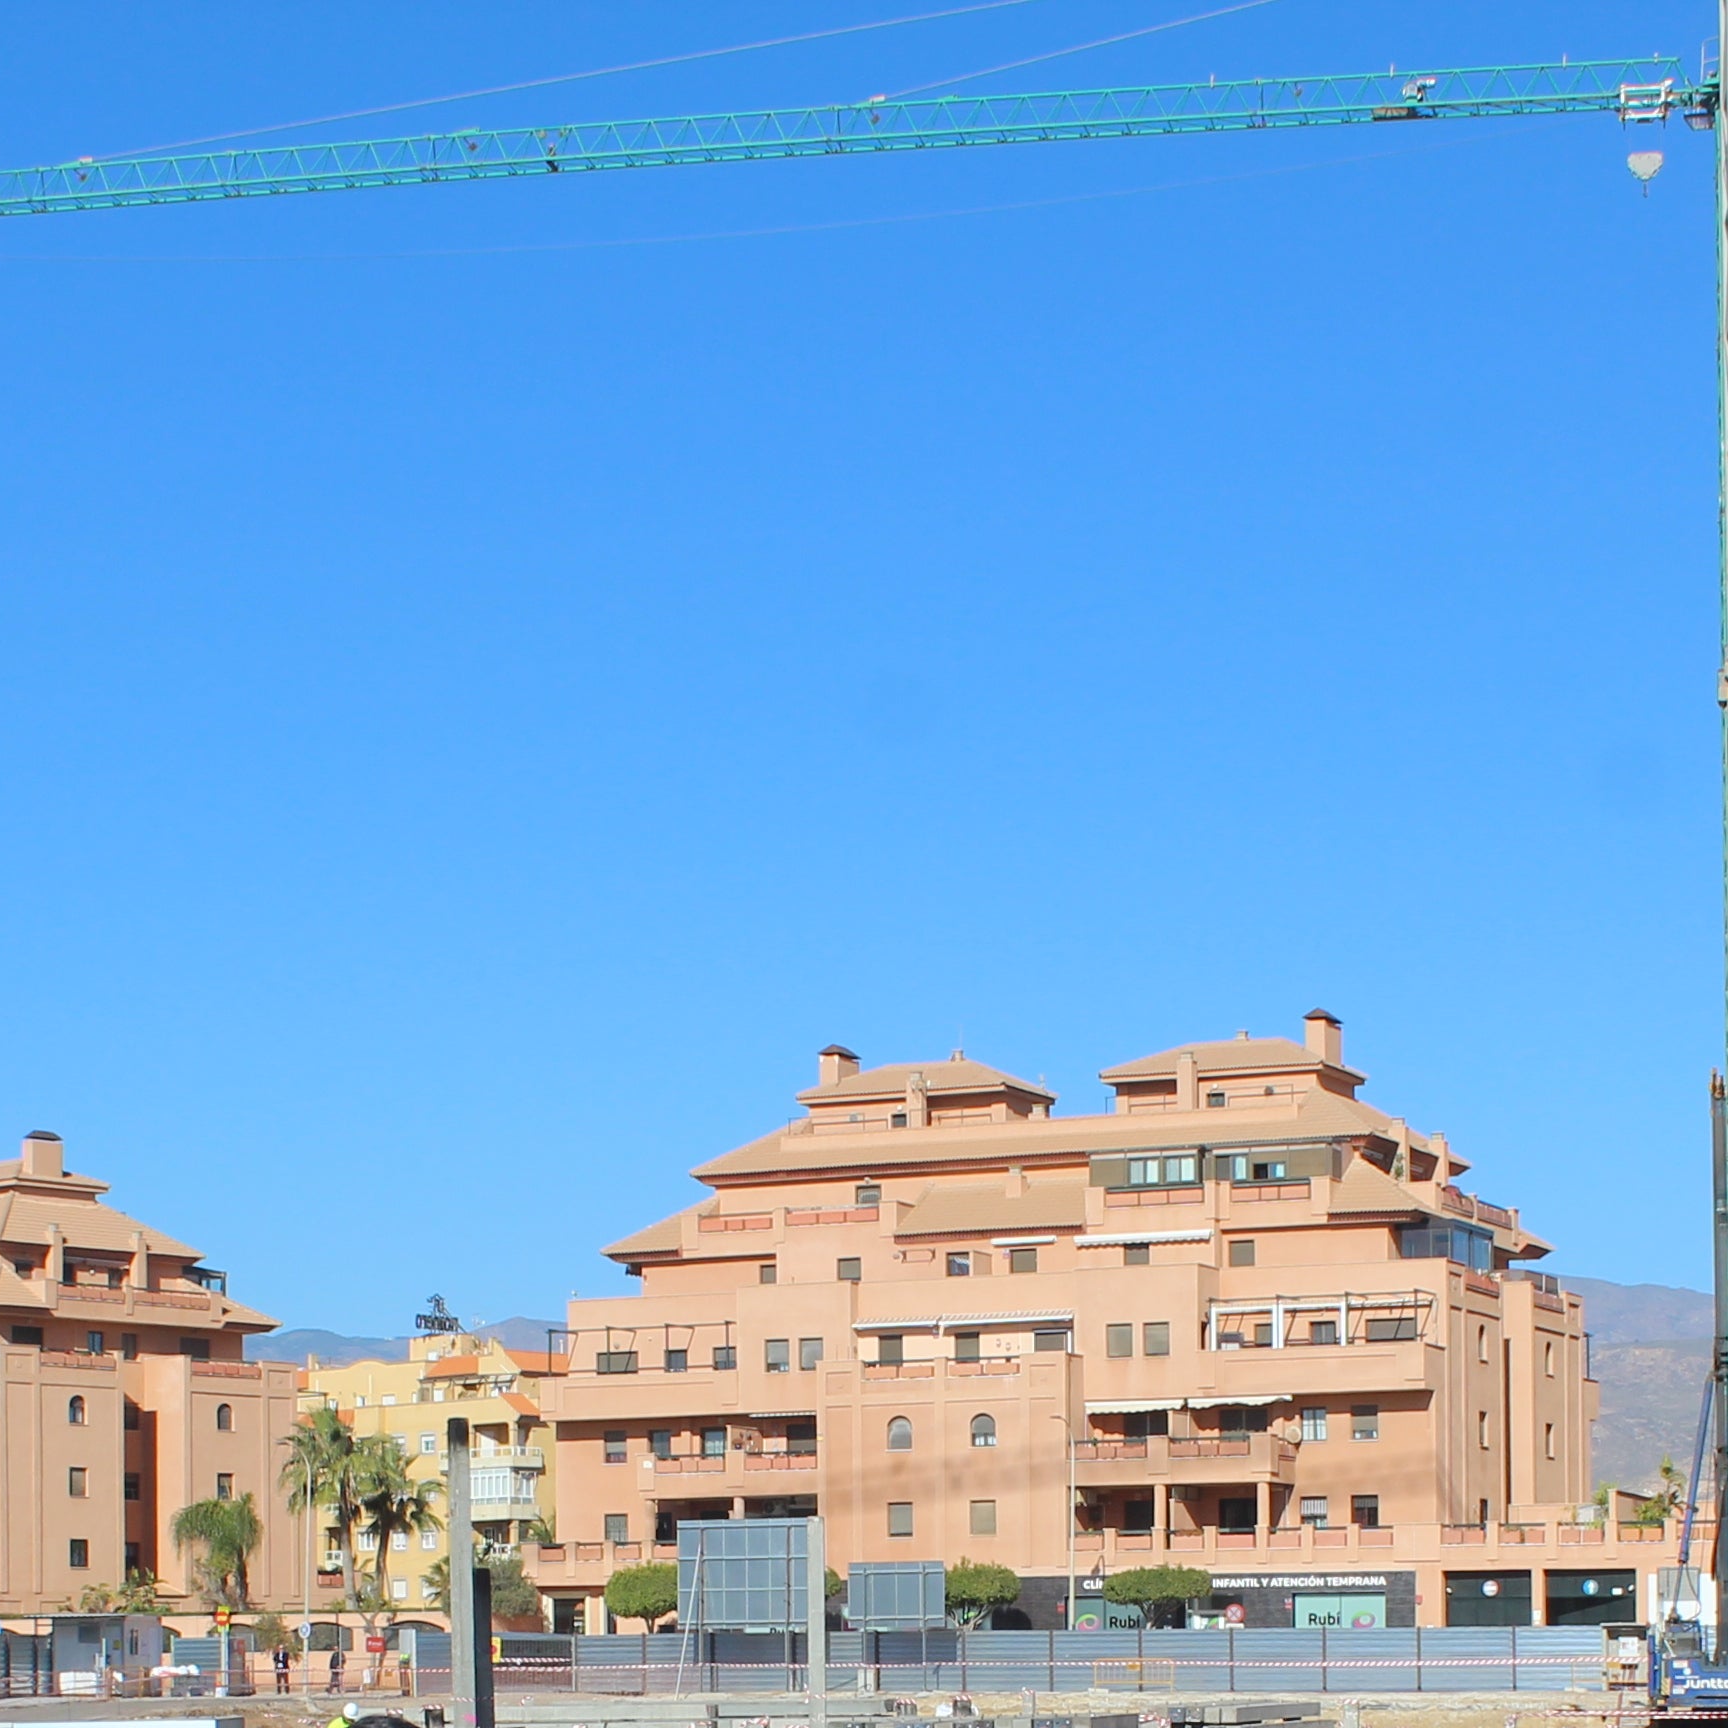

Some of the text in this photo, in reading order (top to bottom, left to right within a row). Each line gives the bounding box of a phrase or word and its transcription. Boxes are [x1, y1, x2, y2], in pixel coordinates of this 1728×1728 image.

[1212, 1575, 1387, 1588] INFANTIL Y ATENCIÓN TEMPRANA
[1109, 1615, 1140, 1628] Rubí
[1308, 1611, 1340, 1626] Rubí
